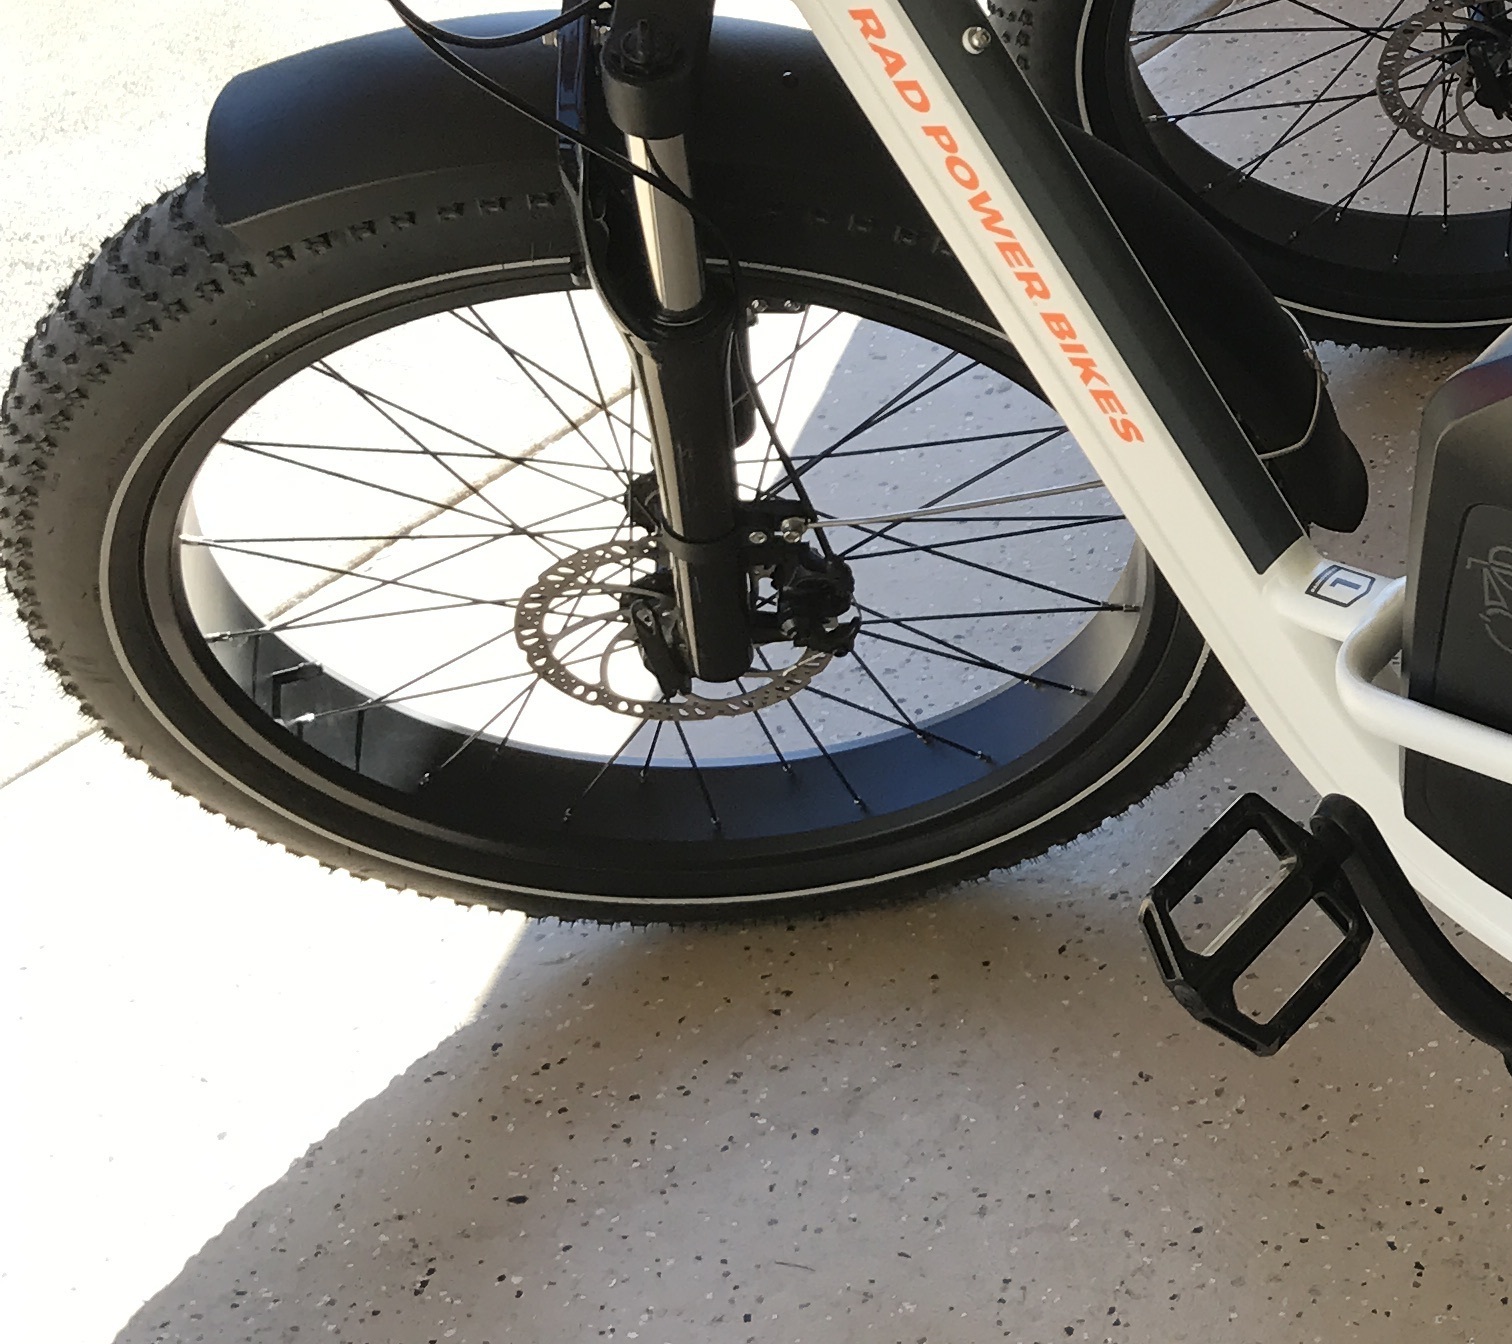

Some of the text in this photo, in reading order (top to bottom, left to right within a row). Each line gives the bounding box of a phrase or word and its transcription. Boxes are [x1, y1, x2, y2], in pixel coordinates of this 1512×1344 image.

[848, 8, 1146, 443] RAD POWER BIKES
